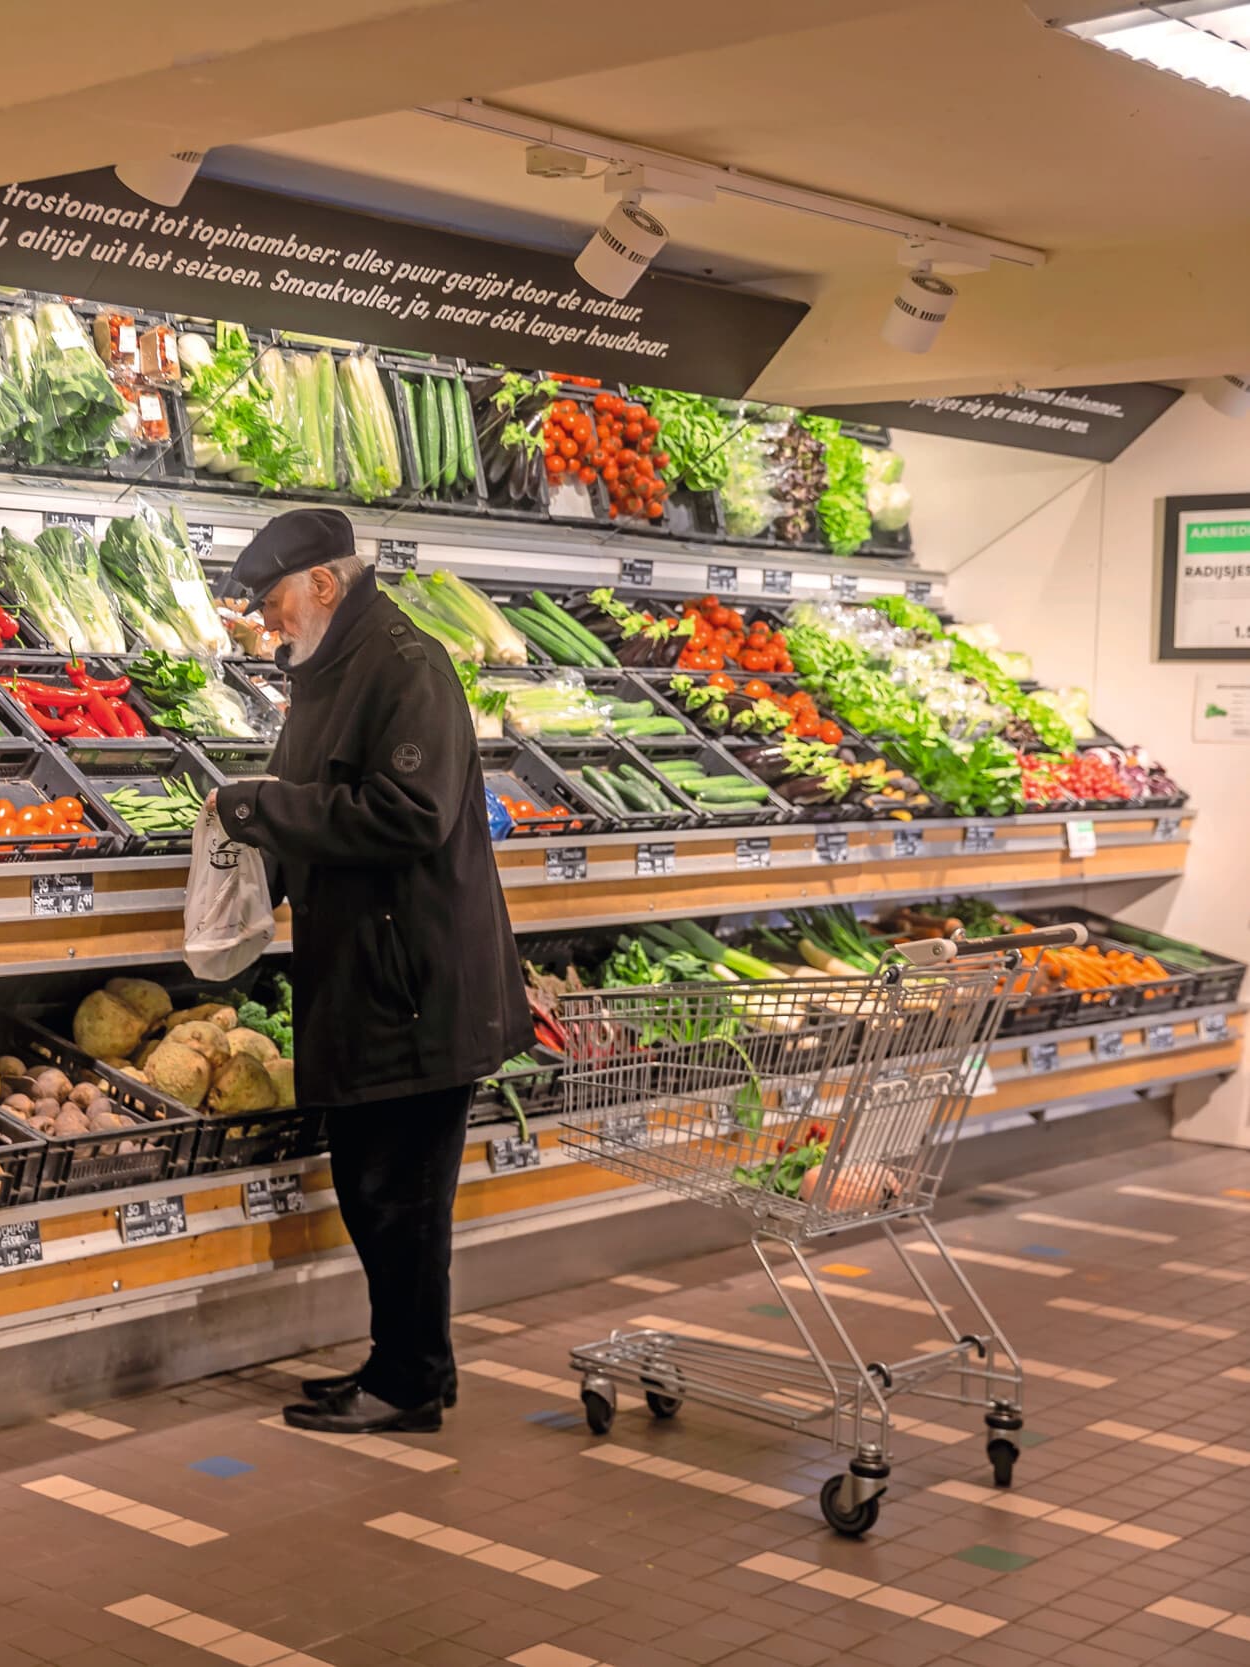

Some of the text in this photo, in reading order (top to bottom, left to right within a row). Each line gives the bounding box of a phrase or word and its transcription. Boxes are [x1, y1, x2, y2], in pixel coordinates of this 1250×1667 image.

[2, 182, 150, 231] trostomaat
[152, 210, 188, 239] tot
[193, 216, 343, 267] topinamboer:
[343, 248, 392, 276] alles
[391, 260, 447, 287] puur
[443, 268, 513, 301] gerijpt
[511, 276, 558, 309] door
[556, 289, 583, 313] de
[581, 297, 642, 323] natuur.
[17, 226, 90, 261] altijd
[90, 238, 128, 265] uit
[128, 243, 173, 273] het
[173, 256, 263, 289] seizoen.
[269, 268, 403, 317] Smaakvoller,
[399, 294, 430, 320] ja,
[435, 304, 491, 328] maar
[524, 312, 586, 346] langer
[584, 325, 669, 360] houdbaar.
